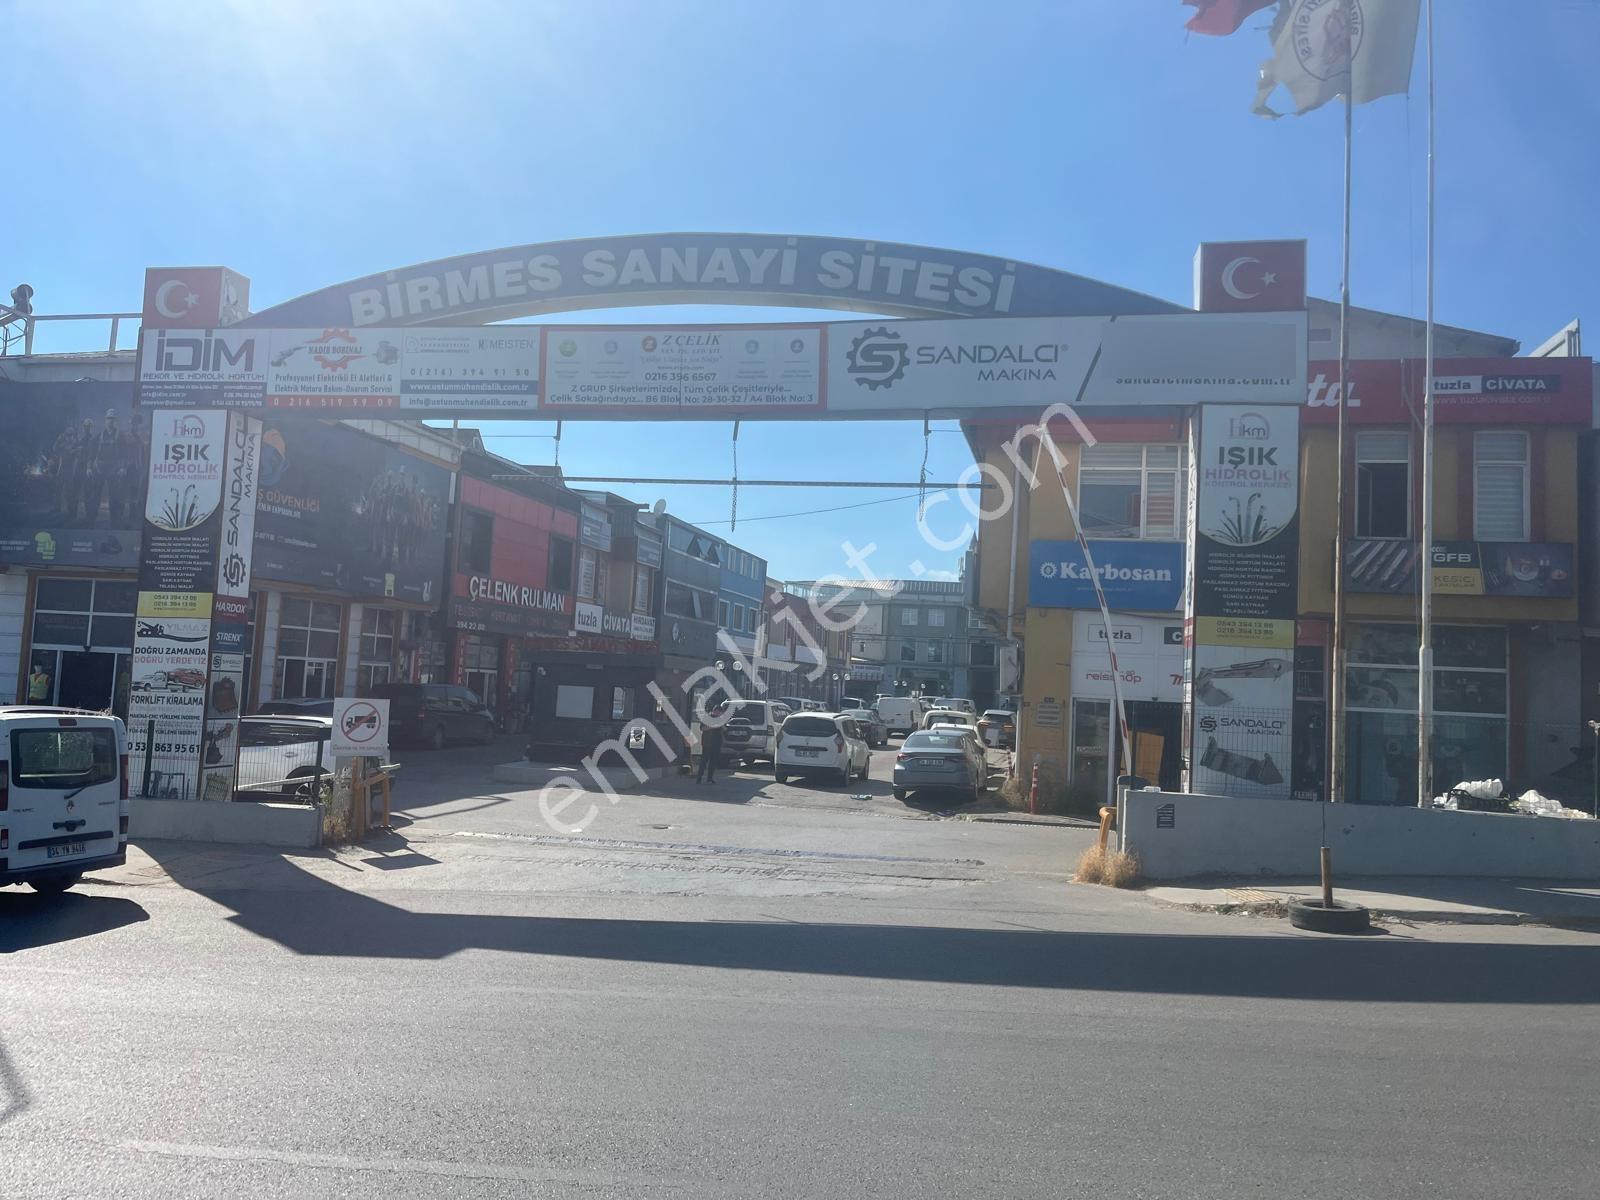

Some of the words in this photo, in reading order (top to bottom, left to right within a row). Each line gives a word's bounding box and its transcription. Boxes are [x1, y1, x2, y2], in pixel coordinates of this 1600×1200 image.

[348, 253, 564, 328] BİRMES
[581, 237, 799, 288] SANAYİ
[816, 242, 1016, 313] SİTESİ
[156, 328, 256, 372] İDİM
[916, 343, 1060, 366] SANDALCI
[174, 373, 185, 381] VE
[644, 372, 669, 382] 0216
[579, 385, 607, 393] GRUP
[1433, 380, 1472, 392] tuzla
[1485, 377, 1548, 392] CİVATA
[164, 443, 211, 466] IŞIK
[1218, 445, 1279, 469] IŞIK
[1059, 561, 1173, 582] Karbosan
[469, 575, 520, 606] ÇELENK
[520, 586, 566, 613] RULMAN
[215, 600, 248, 614] HARDOX
[577, 610, 599, 629] tuzla
[603, 609, 632, 634] CİVATA
[215, 631, 243, 643] STRENX
[134, 646, 164, 656] DOĞRU
[165, 647, 207, 656] ZAMANDA
[130, 693, 167, 706] FORKLİFT
[166, 693, 204, 707] KİRALAMA
[1219, 717, 1283, 730] SANDALCI
[154, 742, 173, 753] 863
[174, 743, 188, 754] 95
[188, 745, 201, 754] 61
